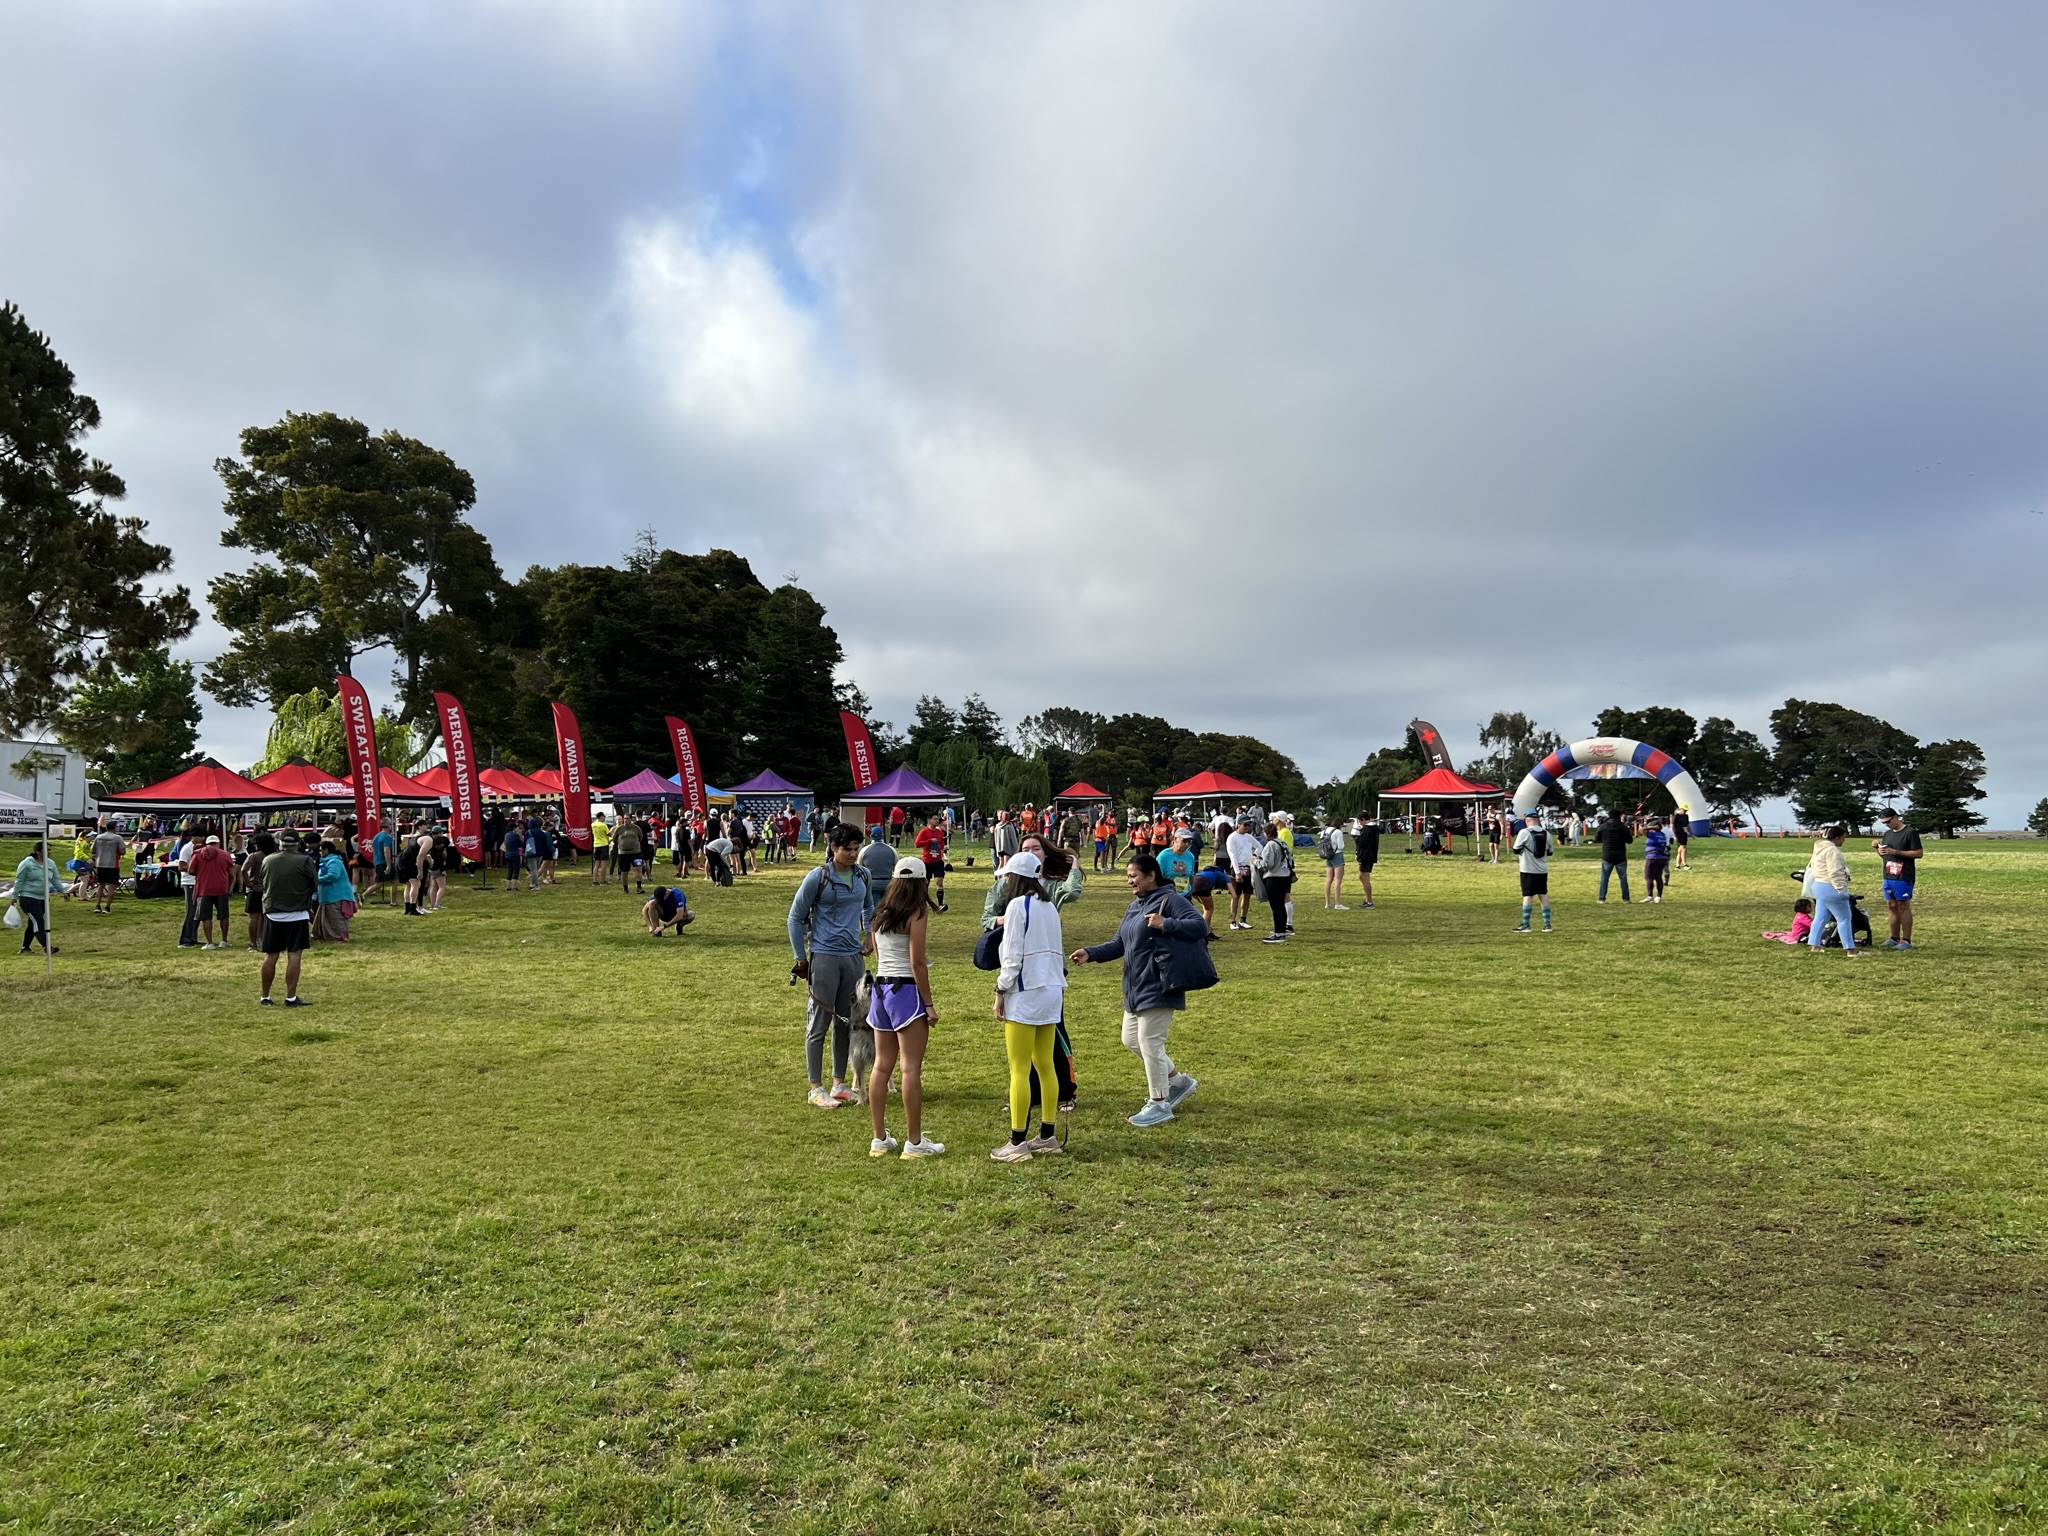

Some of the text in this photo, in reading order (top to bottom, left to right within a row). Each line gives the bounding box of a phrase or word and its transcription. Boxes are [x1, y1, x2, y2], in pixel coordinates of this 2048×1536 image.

[350, 695, 370, 758] SWEAT
[361, 761, 377, 822] CHECK
[447, 706, 472, 821] MERCHANDISE
[564, 737, 581, 794] AWARDS
[676, 727, 700, 811] REGISTRATION
[854, 739, 873, 789] RESULT
